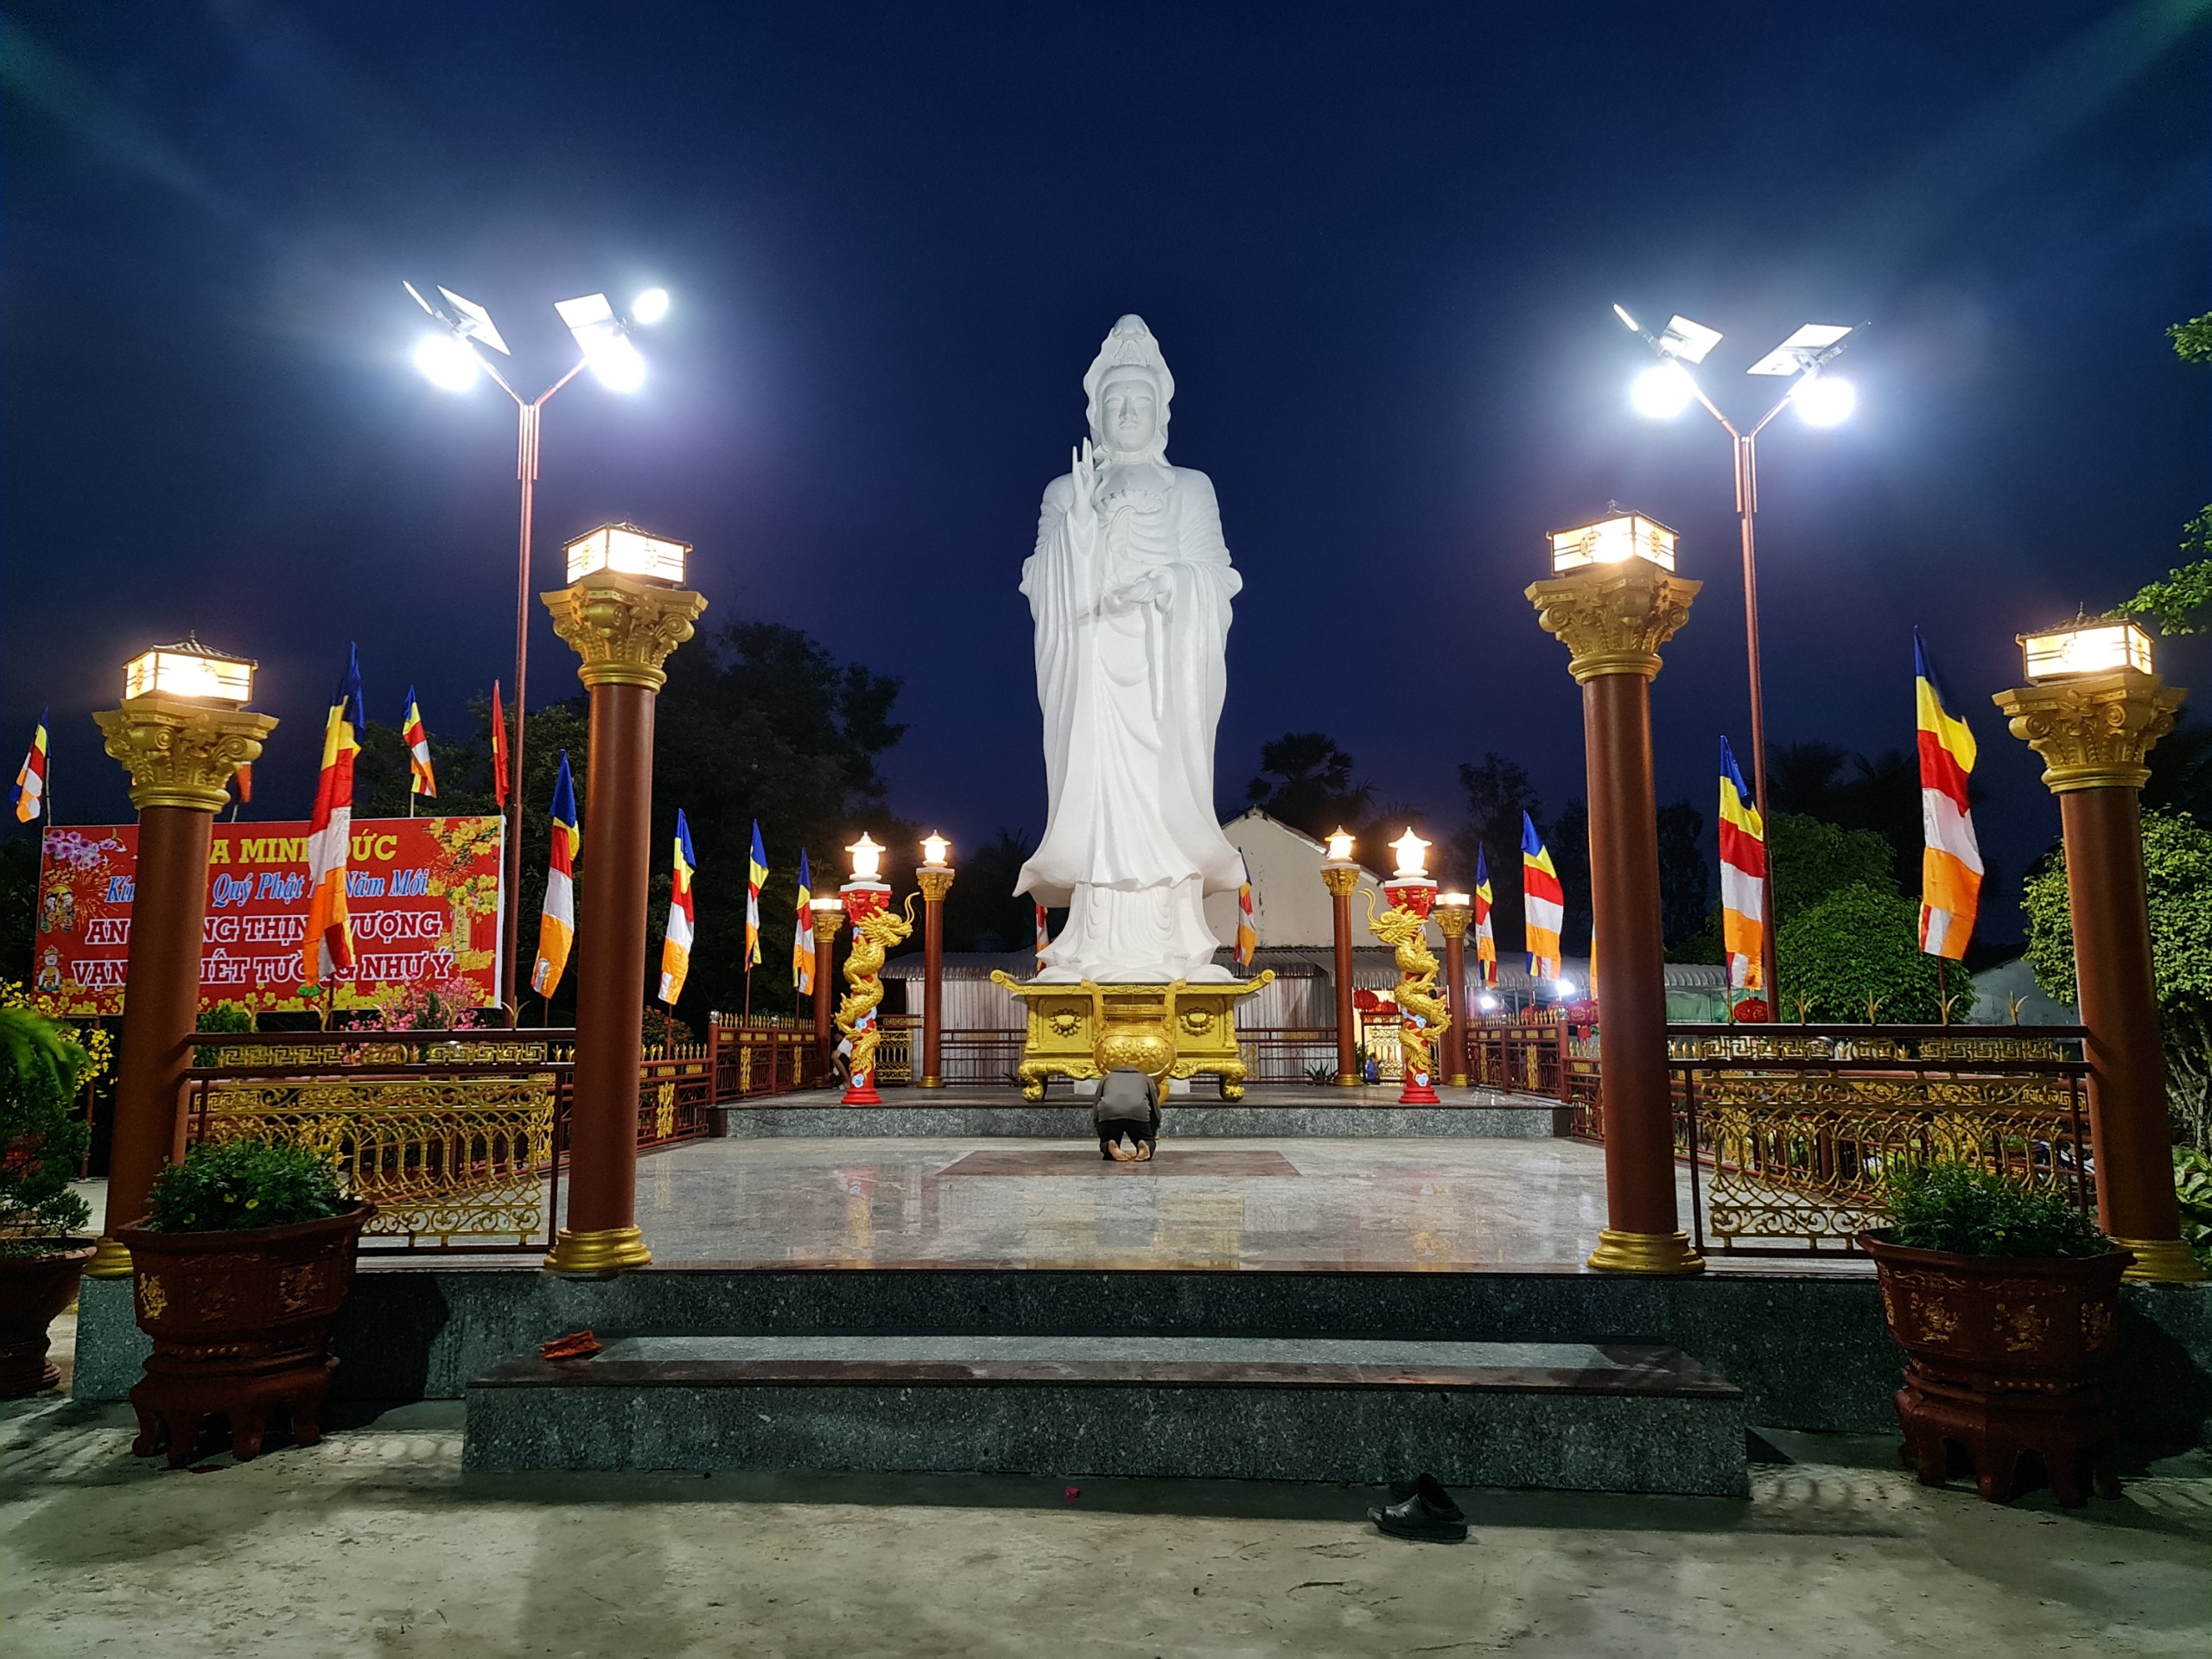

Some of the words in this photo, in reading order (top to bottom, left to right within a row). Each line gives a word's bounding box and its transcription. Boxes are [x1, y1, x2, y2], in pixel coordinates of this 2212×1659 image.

[346, 829, 397, 861] ỨC
[104, 875, 136, 903] Kín
[212, 872, 254, 907] Quý
[255, 871, 305, 905] Phật
[388, 868, 430, 897] Mới
[85, 918, 131, 944] AN
[243, 914, 309, 946] THỊN
[72, 959, 129, 992] VẠN
[200, 948, 251, 984] IẾT
[361, 950, 429, 982] NHƯ
[430, 946, 454, 979] Ý
